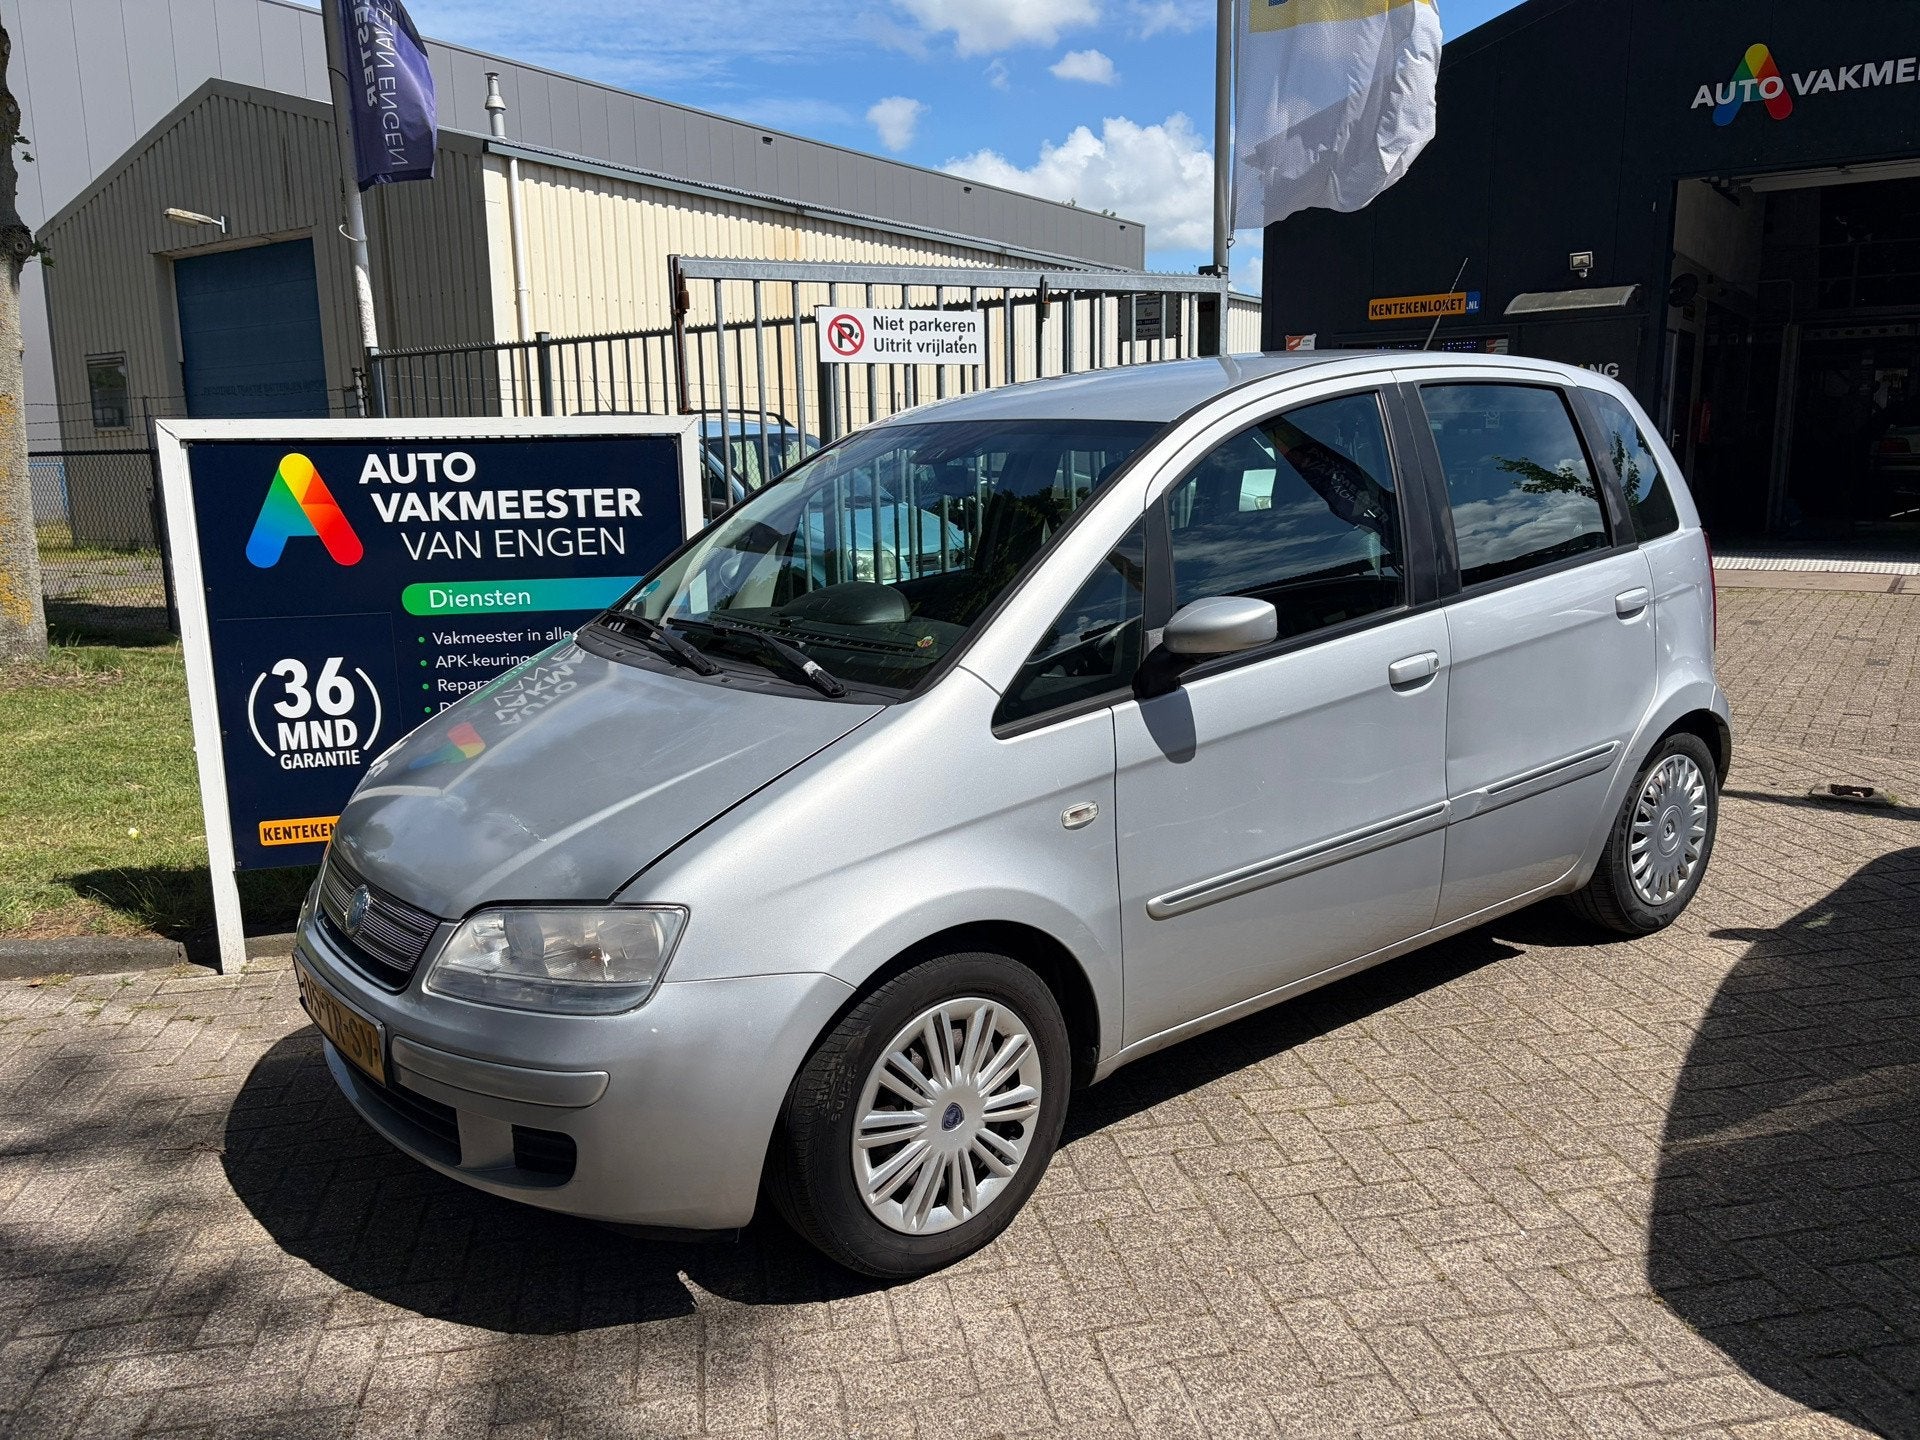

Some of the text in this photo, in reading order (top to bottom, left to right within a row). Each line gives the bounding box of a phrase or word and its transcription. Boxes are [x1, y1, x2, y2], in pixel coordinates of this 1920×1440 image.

[1690, 57, 1920, 109] AUTO VAKME
[873, 315, 976, 335] Niet parkeren
[873, 337, 977, 357] Uitrit vrijlaten
[359, 451, 476, 484] AUTO
[370, 488, 643, 523] VAKMEESTER
[401, 526, 625, 560] VAN ENGEN
[429, 589, 531, 608] Diensten
[432, 630, 523, 645] Vakmeester
[527, 628, 541, 641] in
[271, 656, 355, 719] 36
[277, 719, 358, 751] MND
[280, 749, 361, 770] GARANTIE
